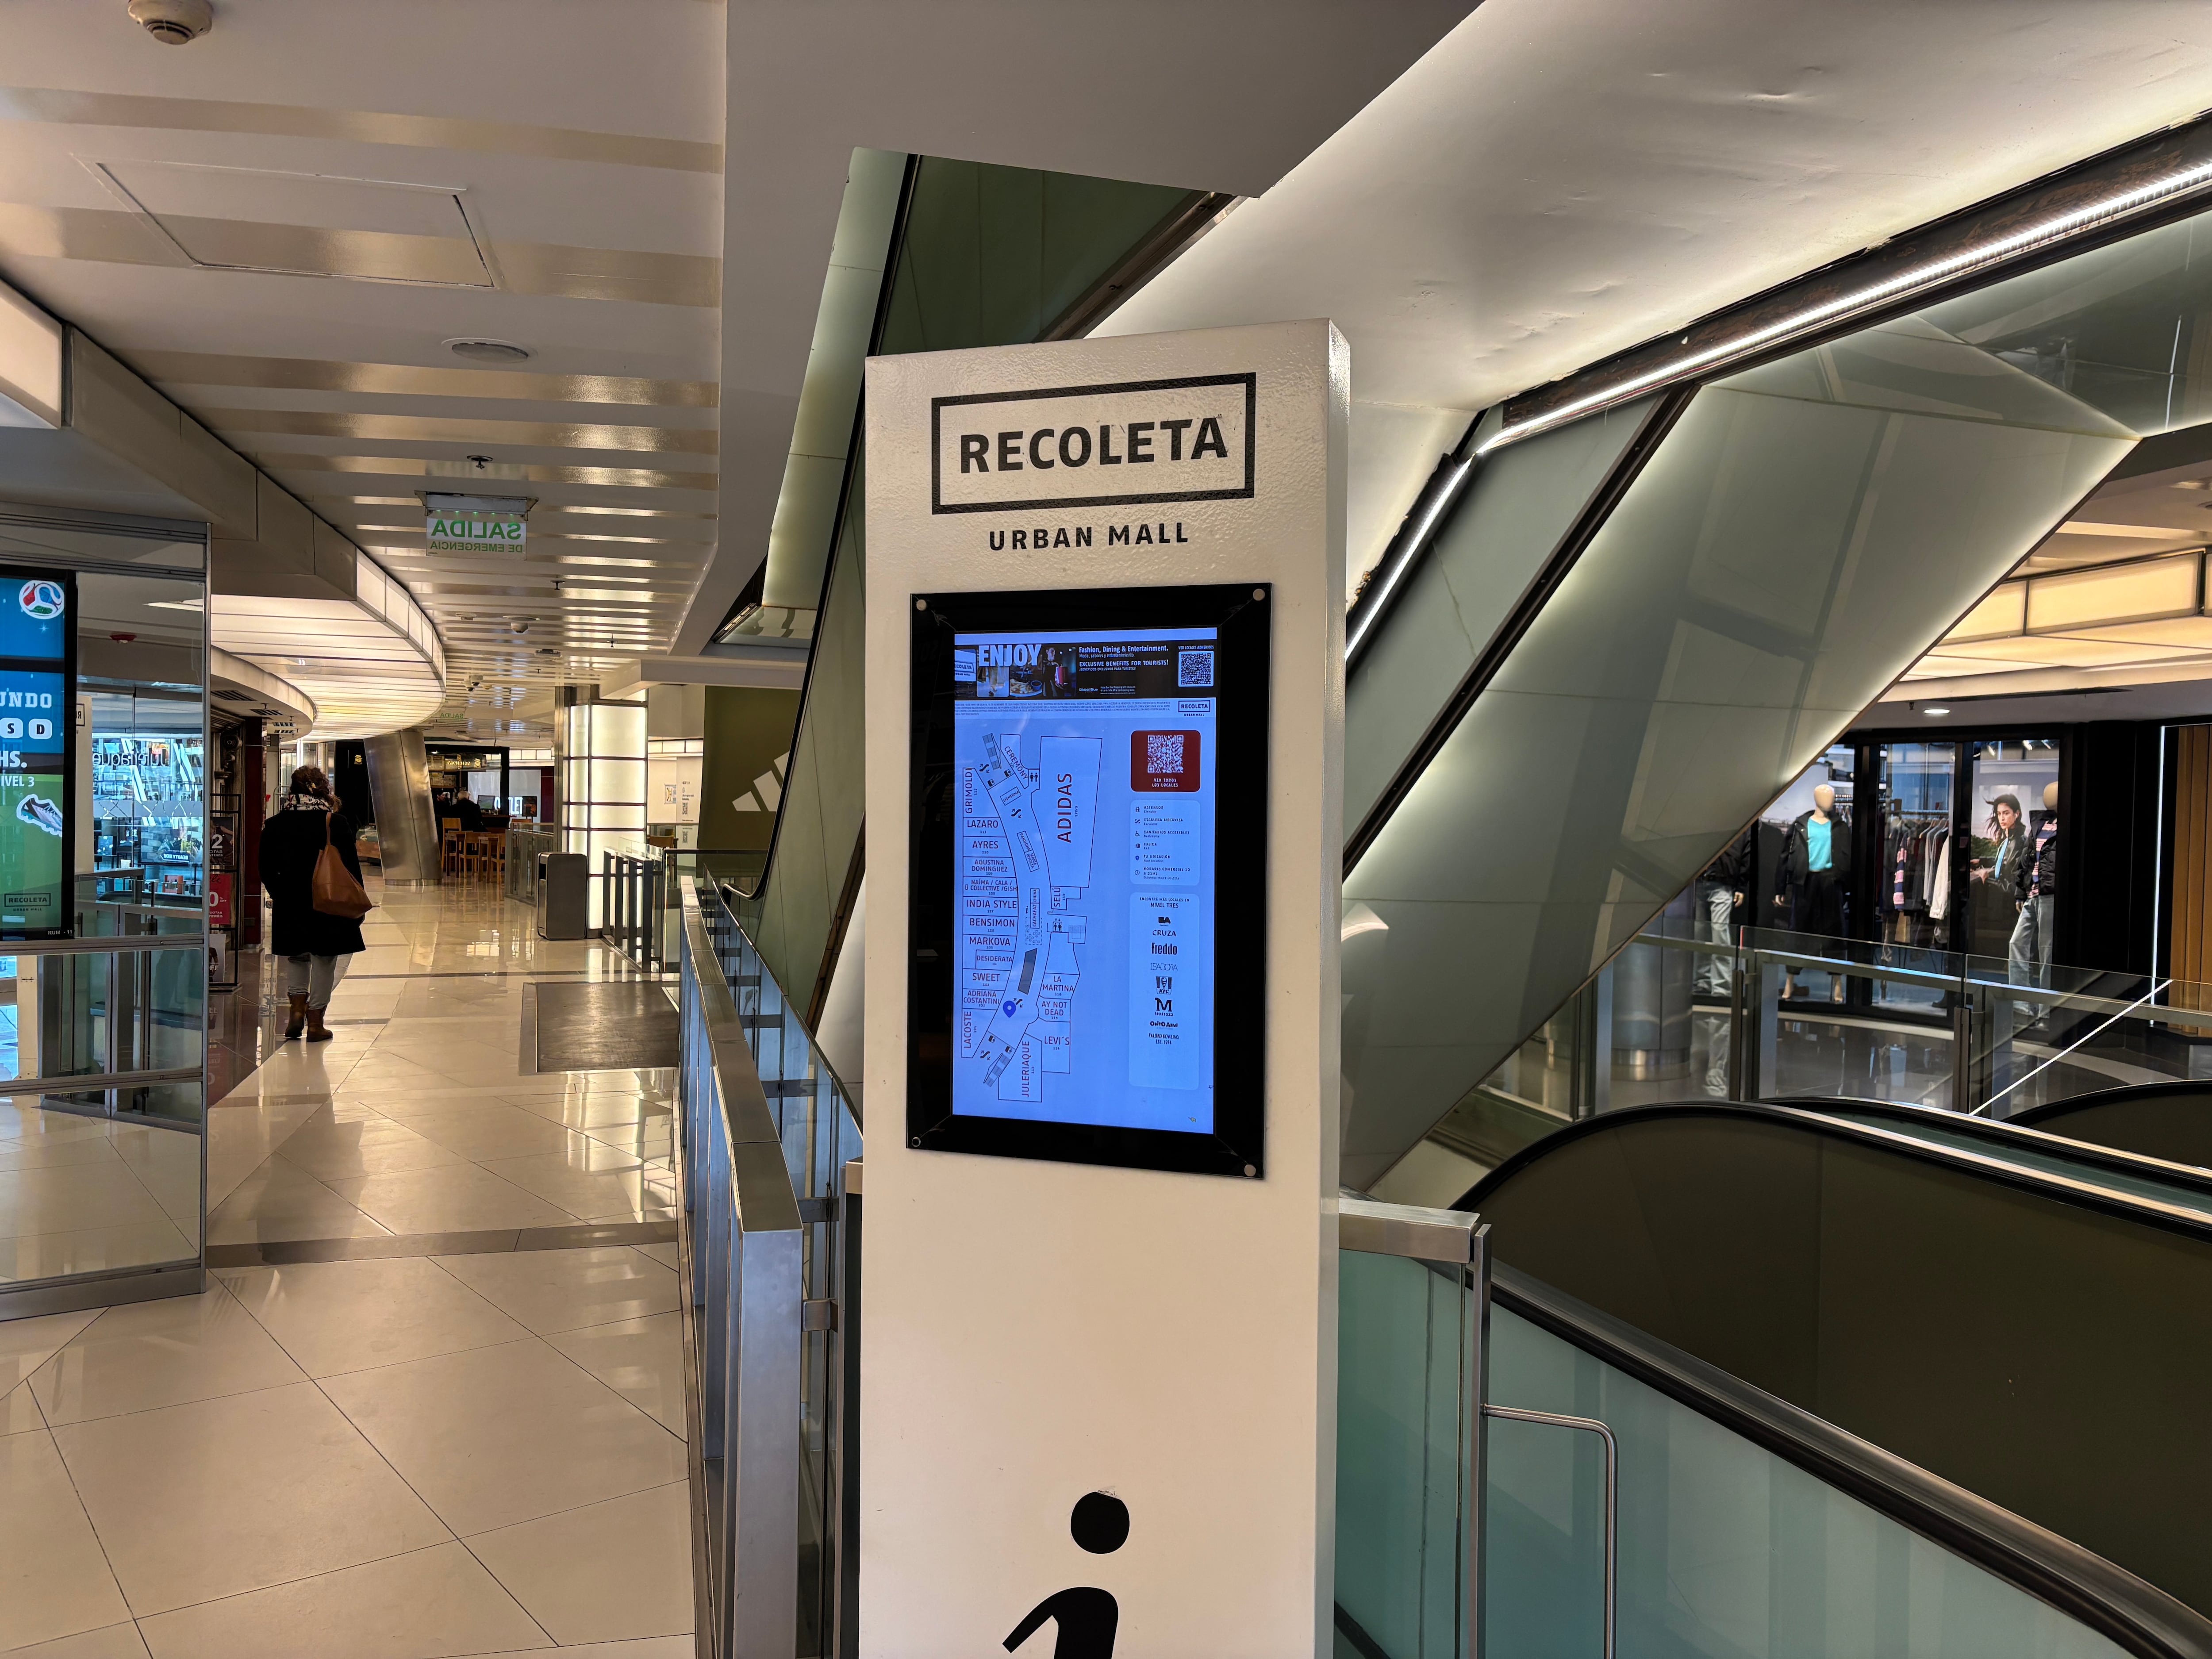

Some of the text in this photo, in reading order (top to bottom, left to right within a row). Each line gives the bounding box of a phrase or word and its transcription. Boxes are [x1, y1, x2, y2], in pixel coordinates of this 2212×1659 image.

[960, 417, 1228, 474] RECOLETA
[989, 522, 1188, 551] URBAN MALL
[979, 644, 1042, 667] ENJOY
[7, 723, 45, 735] S D
[1005, 746, 1029, 779] CEREMONY
[28, 776, 35, 787] 3
[494, 796, 523, 814] OLET
[1057, 773, 1072, 843] ADIDAS
[967, 819, 998, 828] LAZARO
[972, 841, 998, 849] AYRES
[1052, 887, 1061, 907] SELÚ
[967, 899, 1017, 909] INDIA STYLE
[969, 918, 1015, 927] BENSIMON
[969, 936, 1010, 946] MARKOVA
[972, 972, 1000, 982] SWEET
[1042, 983, 1075, 992] MARTINA
[1155, 997, 1172, 1012] M
[1022, 1041, 1031, 1098] JULERIAQUE
